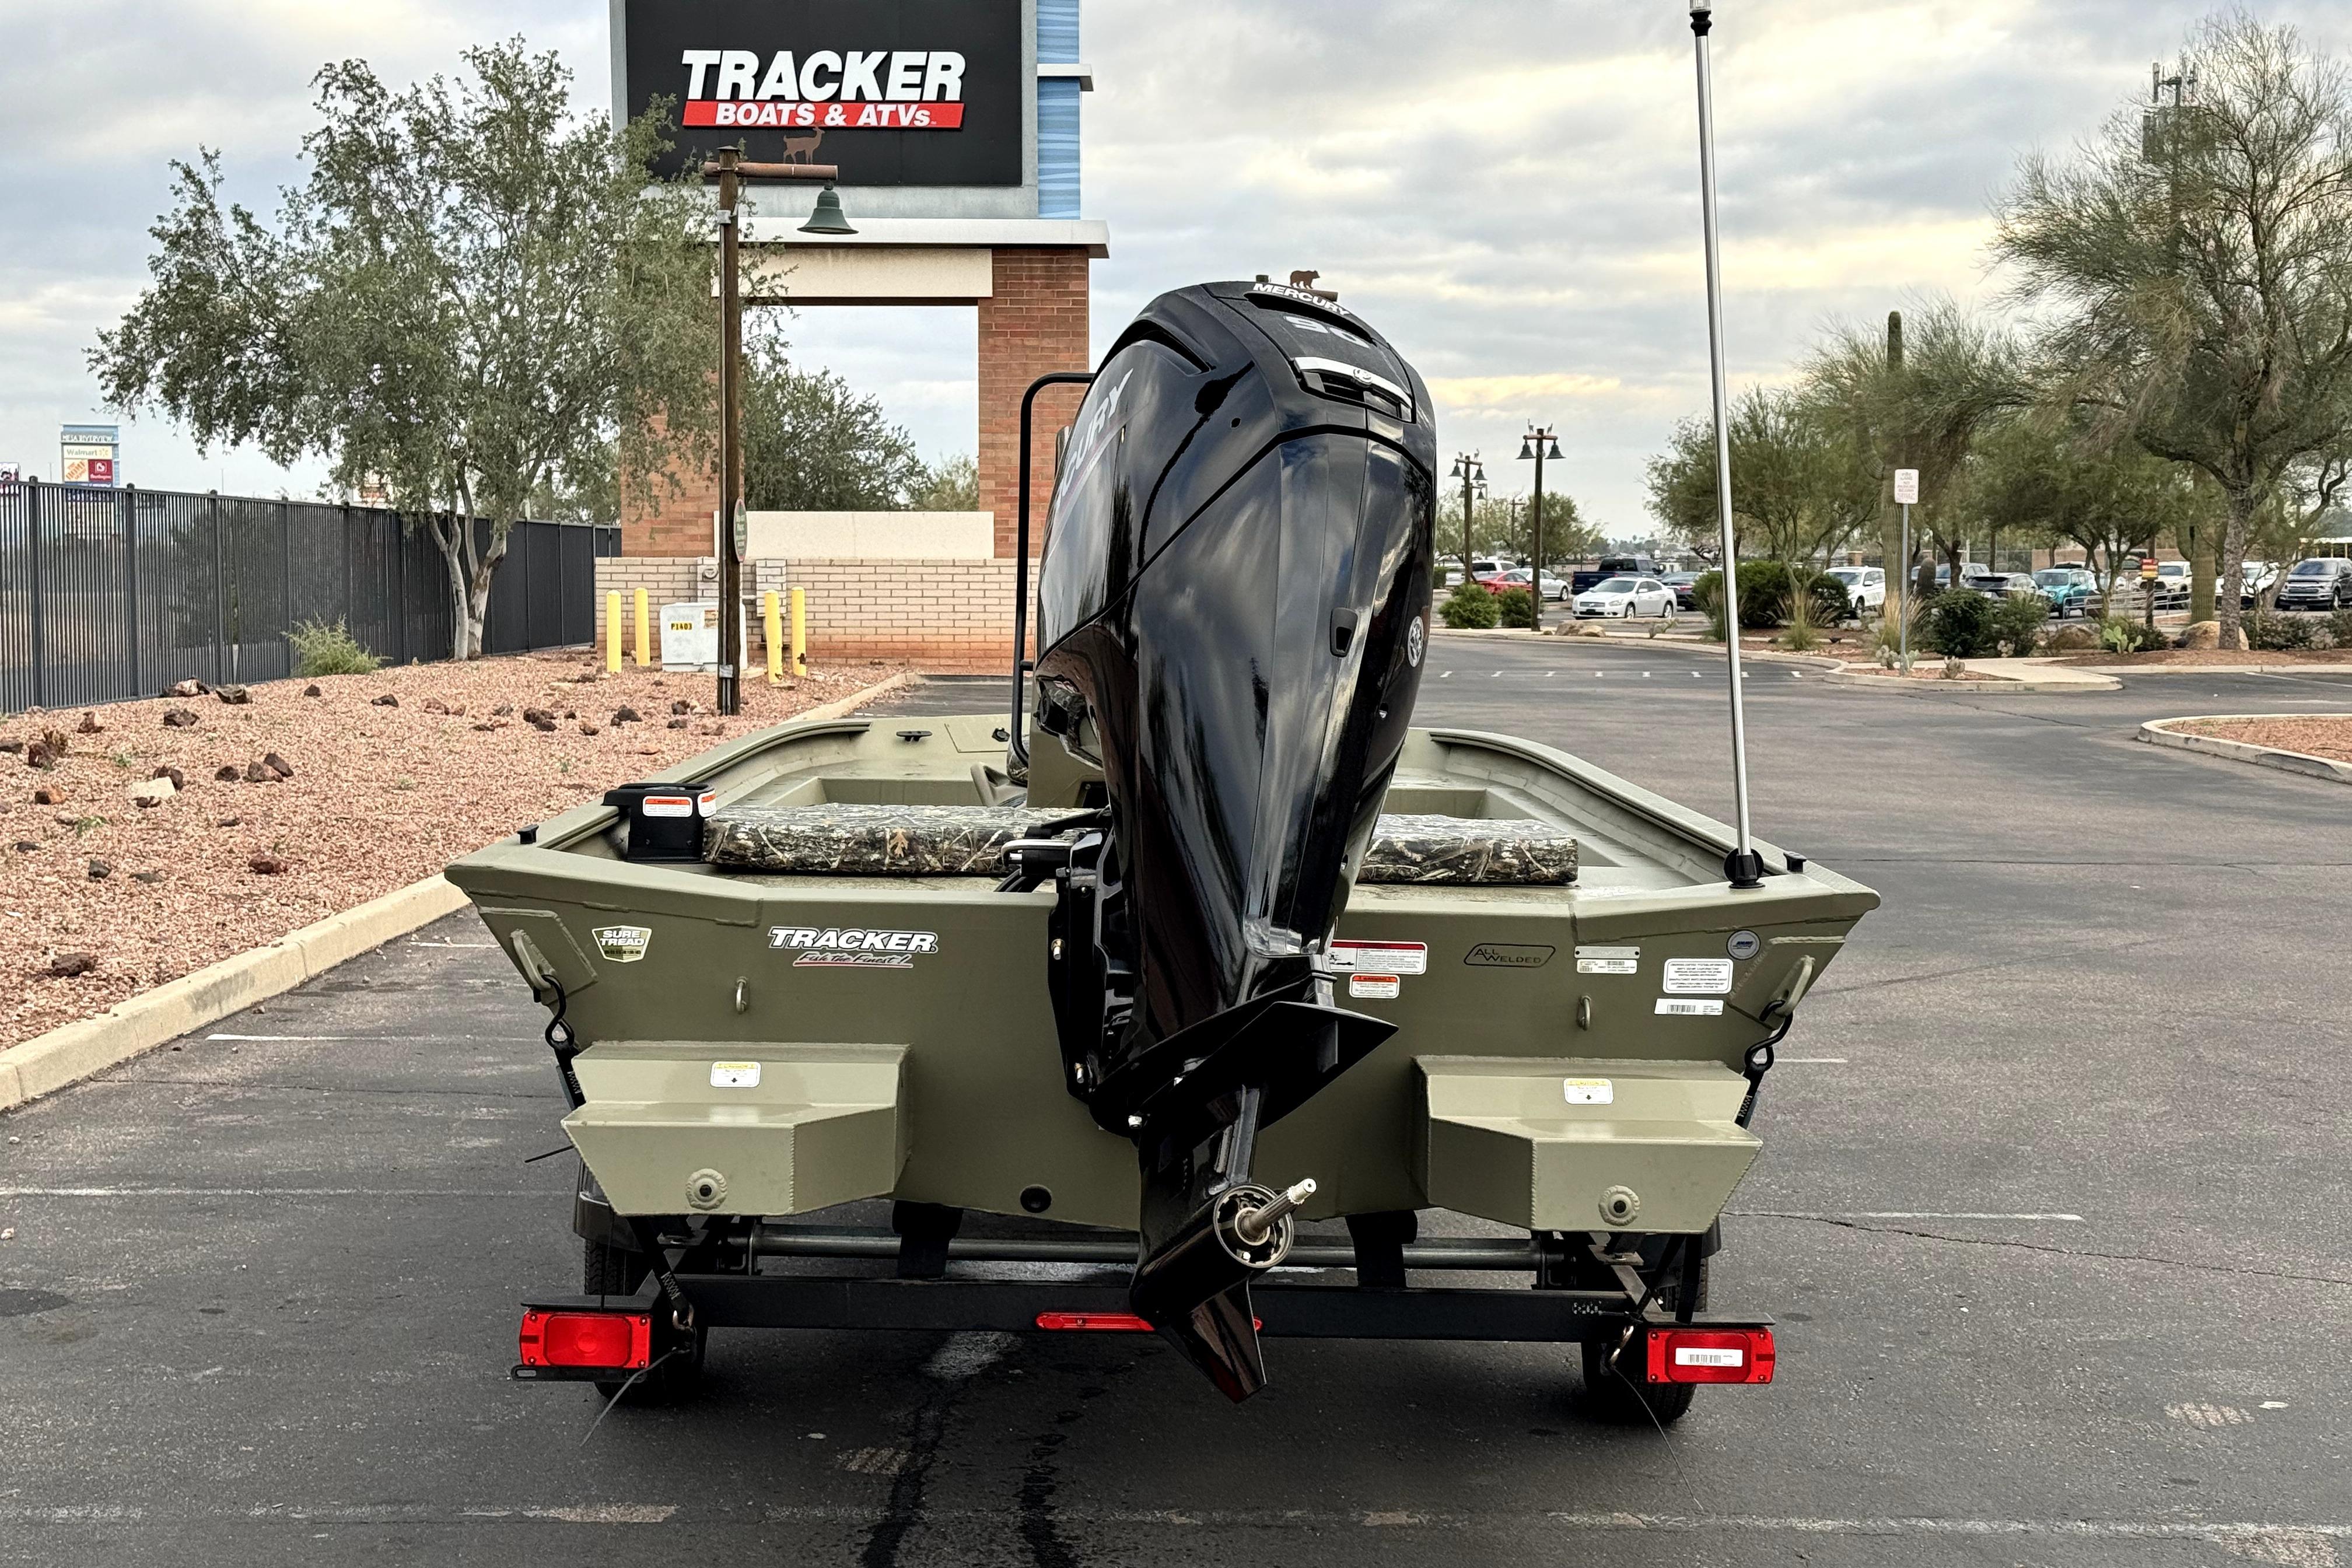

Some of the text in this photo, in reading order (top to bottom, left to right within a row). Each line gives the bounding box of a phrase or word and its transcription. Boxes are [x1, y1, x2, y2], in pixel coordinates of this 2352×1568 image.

[681, 50, 966, 102] TRACKER
[715, 103, 932, 127] BOATS & ATVs
[1254, 283, 1350, 316] MERCURY
[603, 930, 640, 938] SURE
[771, 929, 935, 952] TRACKER
[799, 953, 827, 961] Fish
[831, 953, 851, 962] the
[1474, 949, 1500, 958] ALL
[1482, 952, 1542, 963] WELDED
